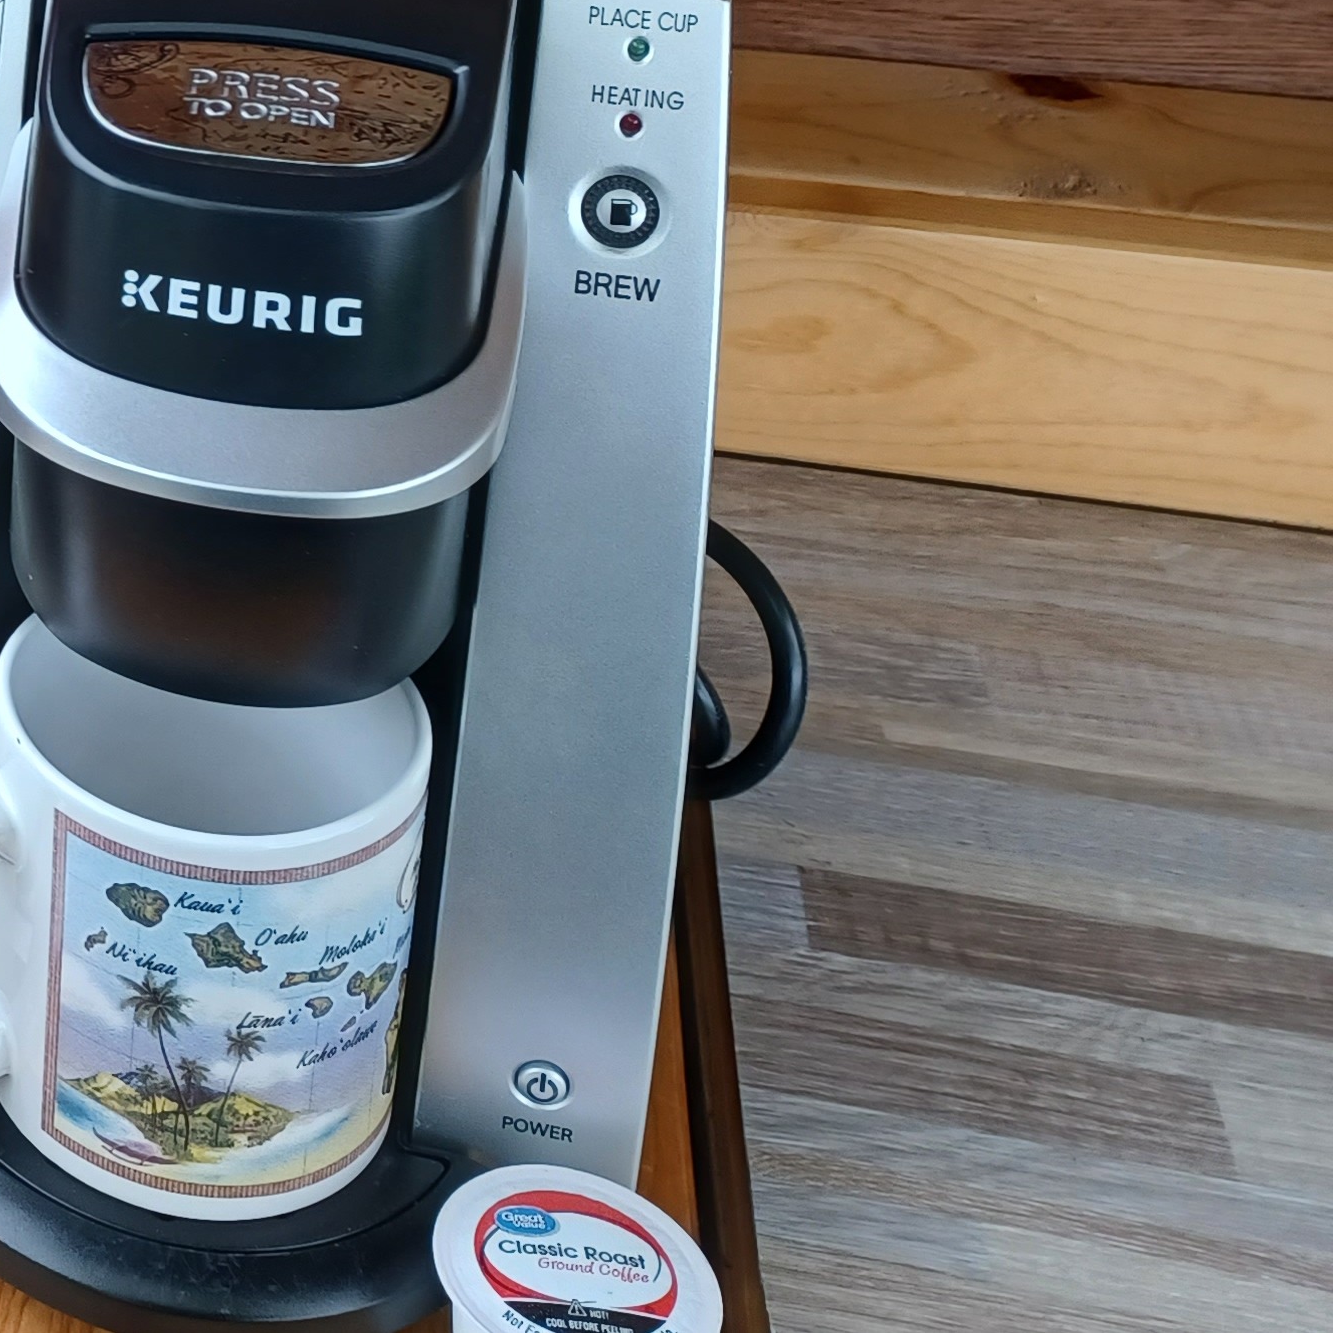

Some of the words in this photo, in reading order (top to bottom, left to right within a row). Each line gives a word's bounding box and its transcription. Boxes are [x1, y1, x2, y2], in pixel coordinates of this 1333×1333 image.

[588, 6, 651, 31] PLACE
[656, 10, 699, 34] CUP
[187, 67, 341, 107] PRESS
[590, 83, 685, 111] HEATING
[183, 95, 225, 118] TO
[239, 99, 336, 129] OPEN
[573, 270, 661, 303] BREW
[120, 268, 364, 337] KEURIG
[501, 1115, 574, 1143] POWER
[500, 1210, 546, 1224] Great
[512, 1218, 547, 1230] Value
[497, 1239, 579, 1259] Classic
[584, 1245, 646, 1270] Roast
[537, 1257, 595, 1275] Ground
[598, 1263, 650, 1284] Coffee
[500, 1308, 523, 1328] Not
